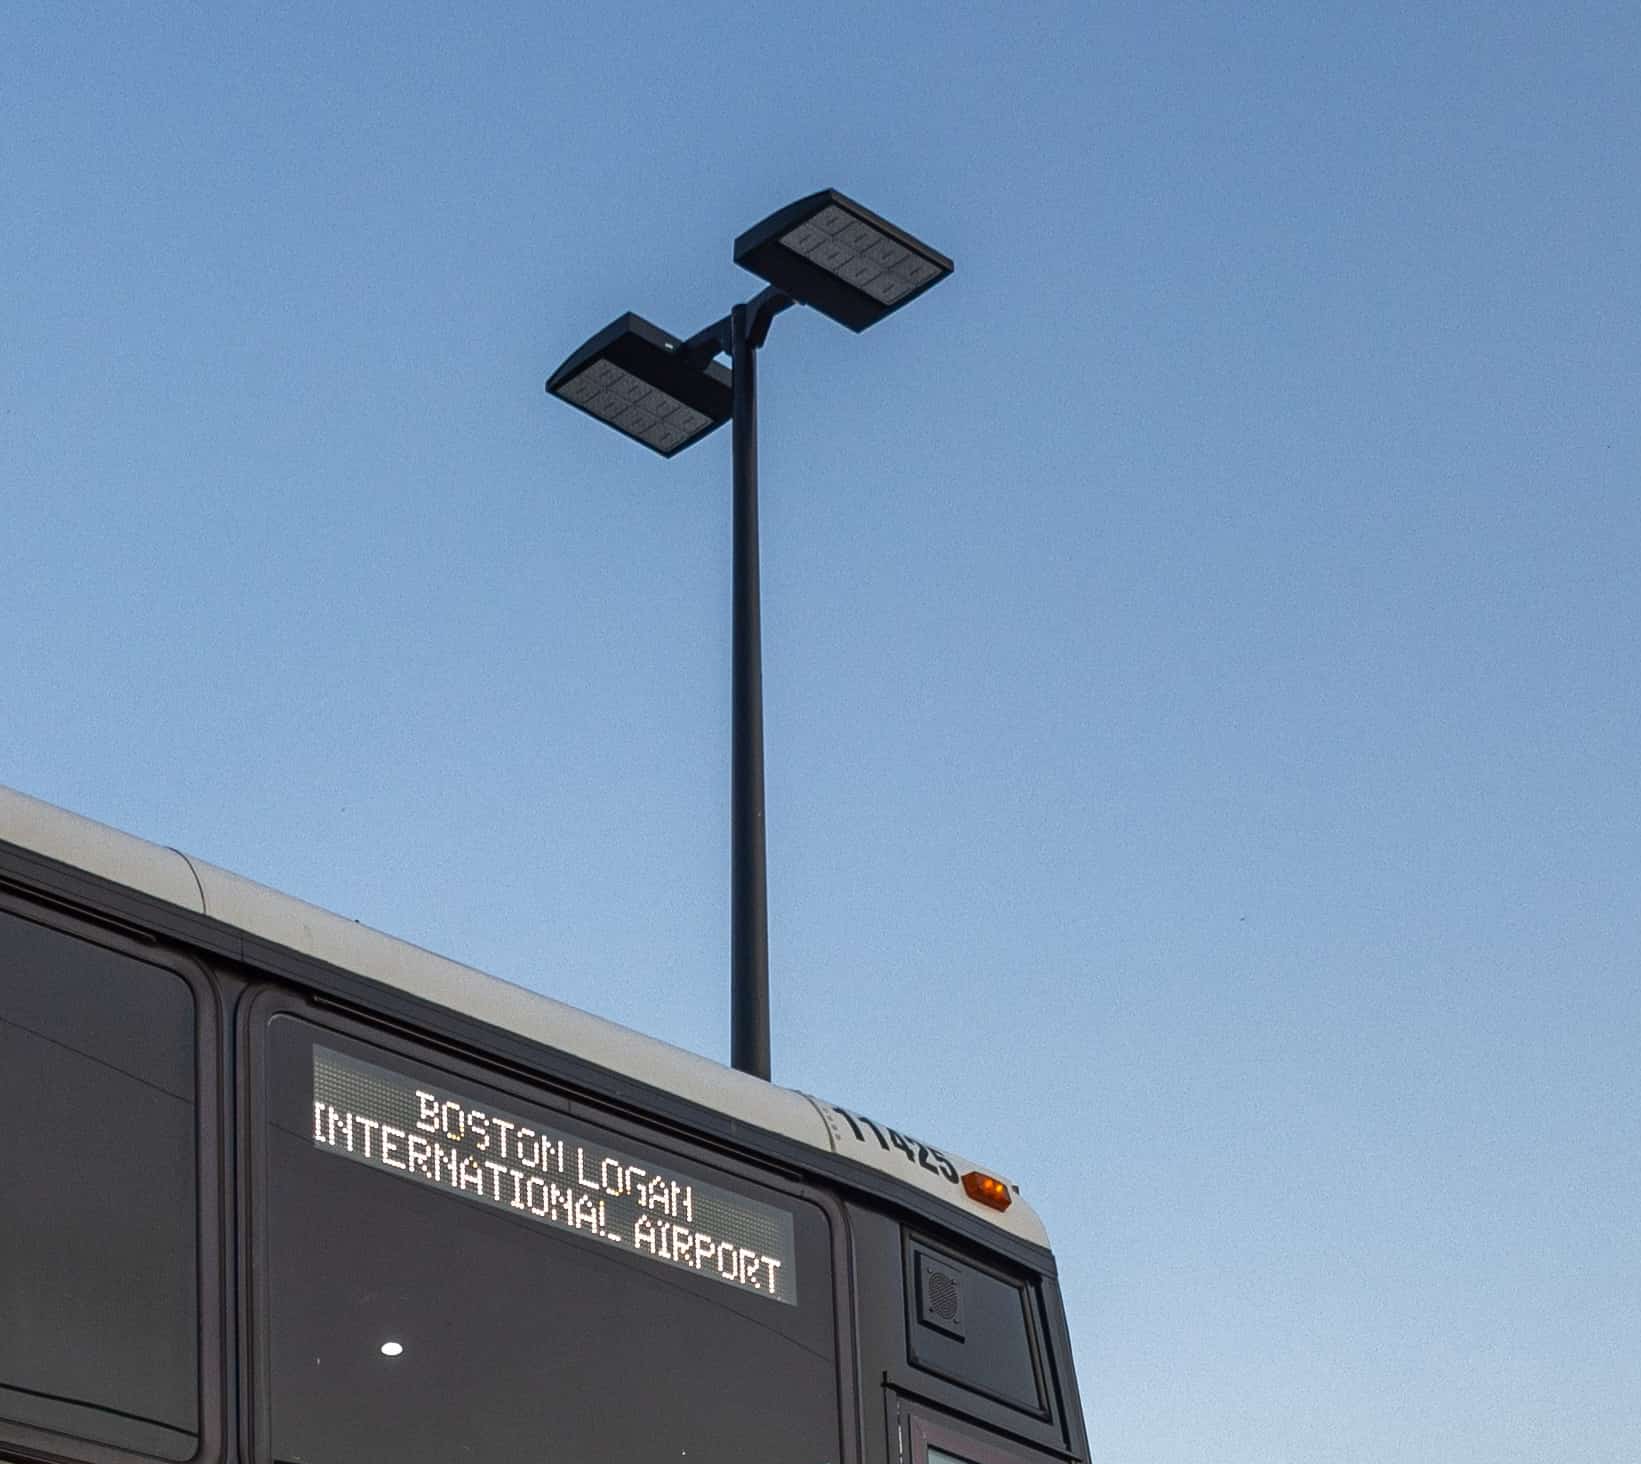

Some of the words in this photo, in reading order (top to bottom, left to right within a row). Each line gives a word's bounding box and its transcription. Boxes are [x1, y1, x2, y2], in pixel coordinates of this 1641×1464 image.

[313, 1101, 622, 1243] INTERNATIONAL
[634, 1213, 781, 1295] AIRPORT
[415, 1090, 565, 1173] BOSTON
[577, 1147, 693, 1223] LOGAN
[832, 1106, 960, 1185] 11425
